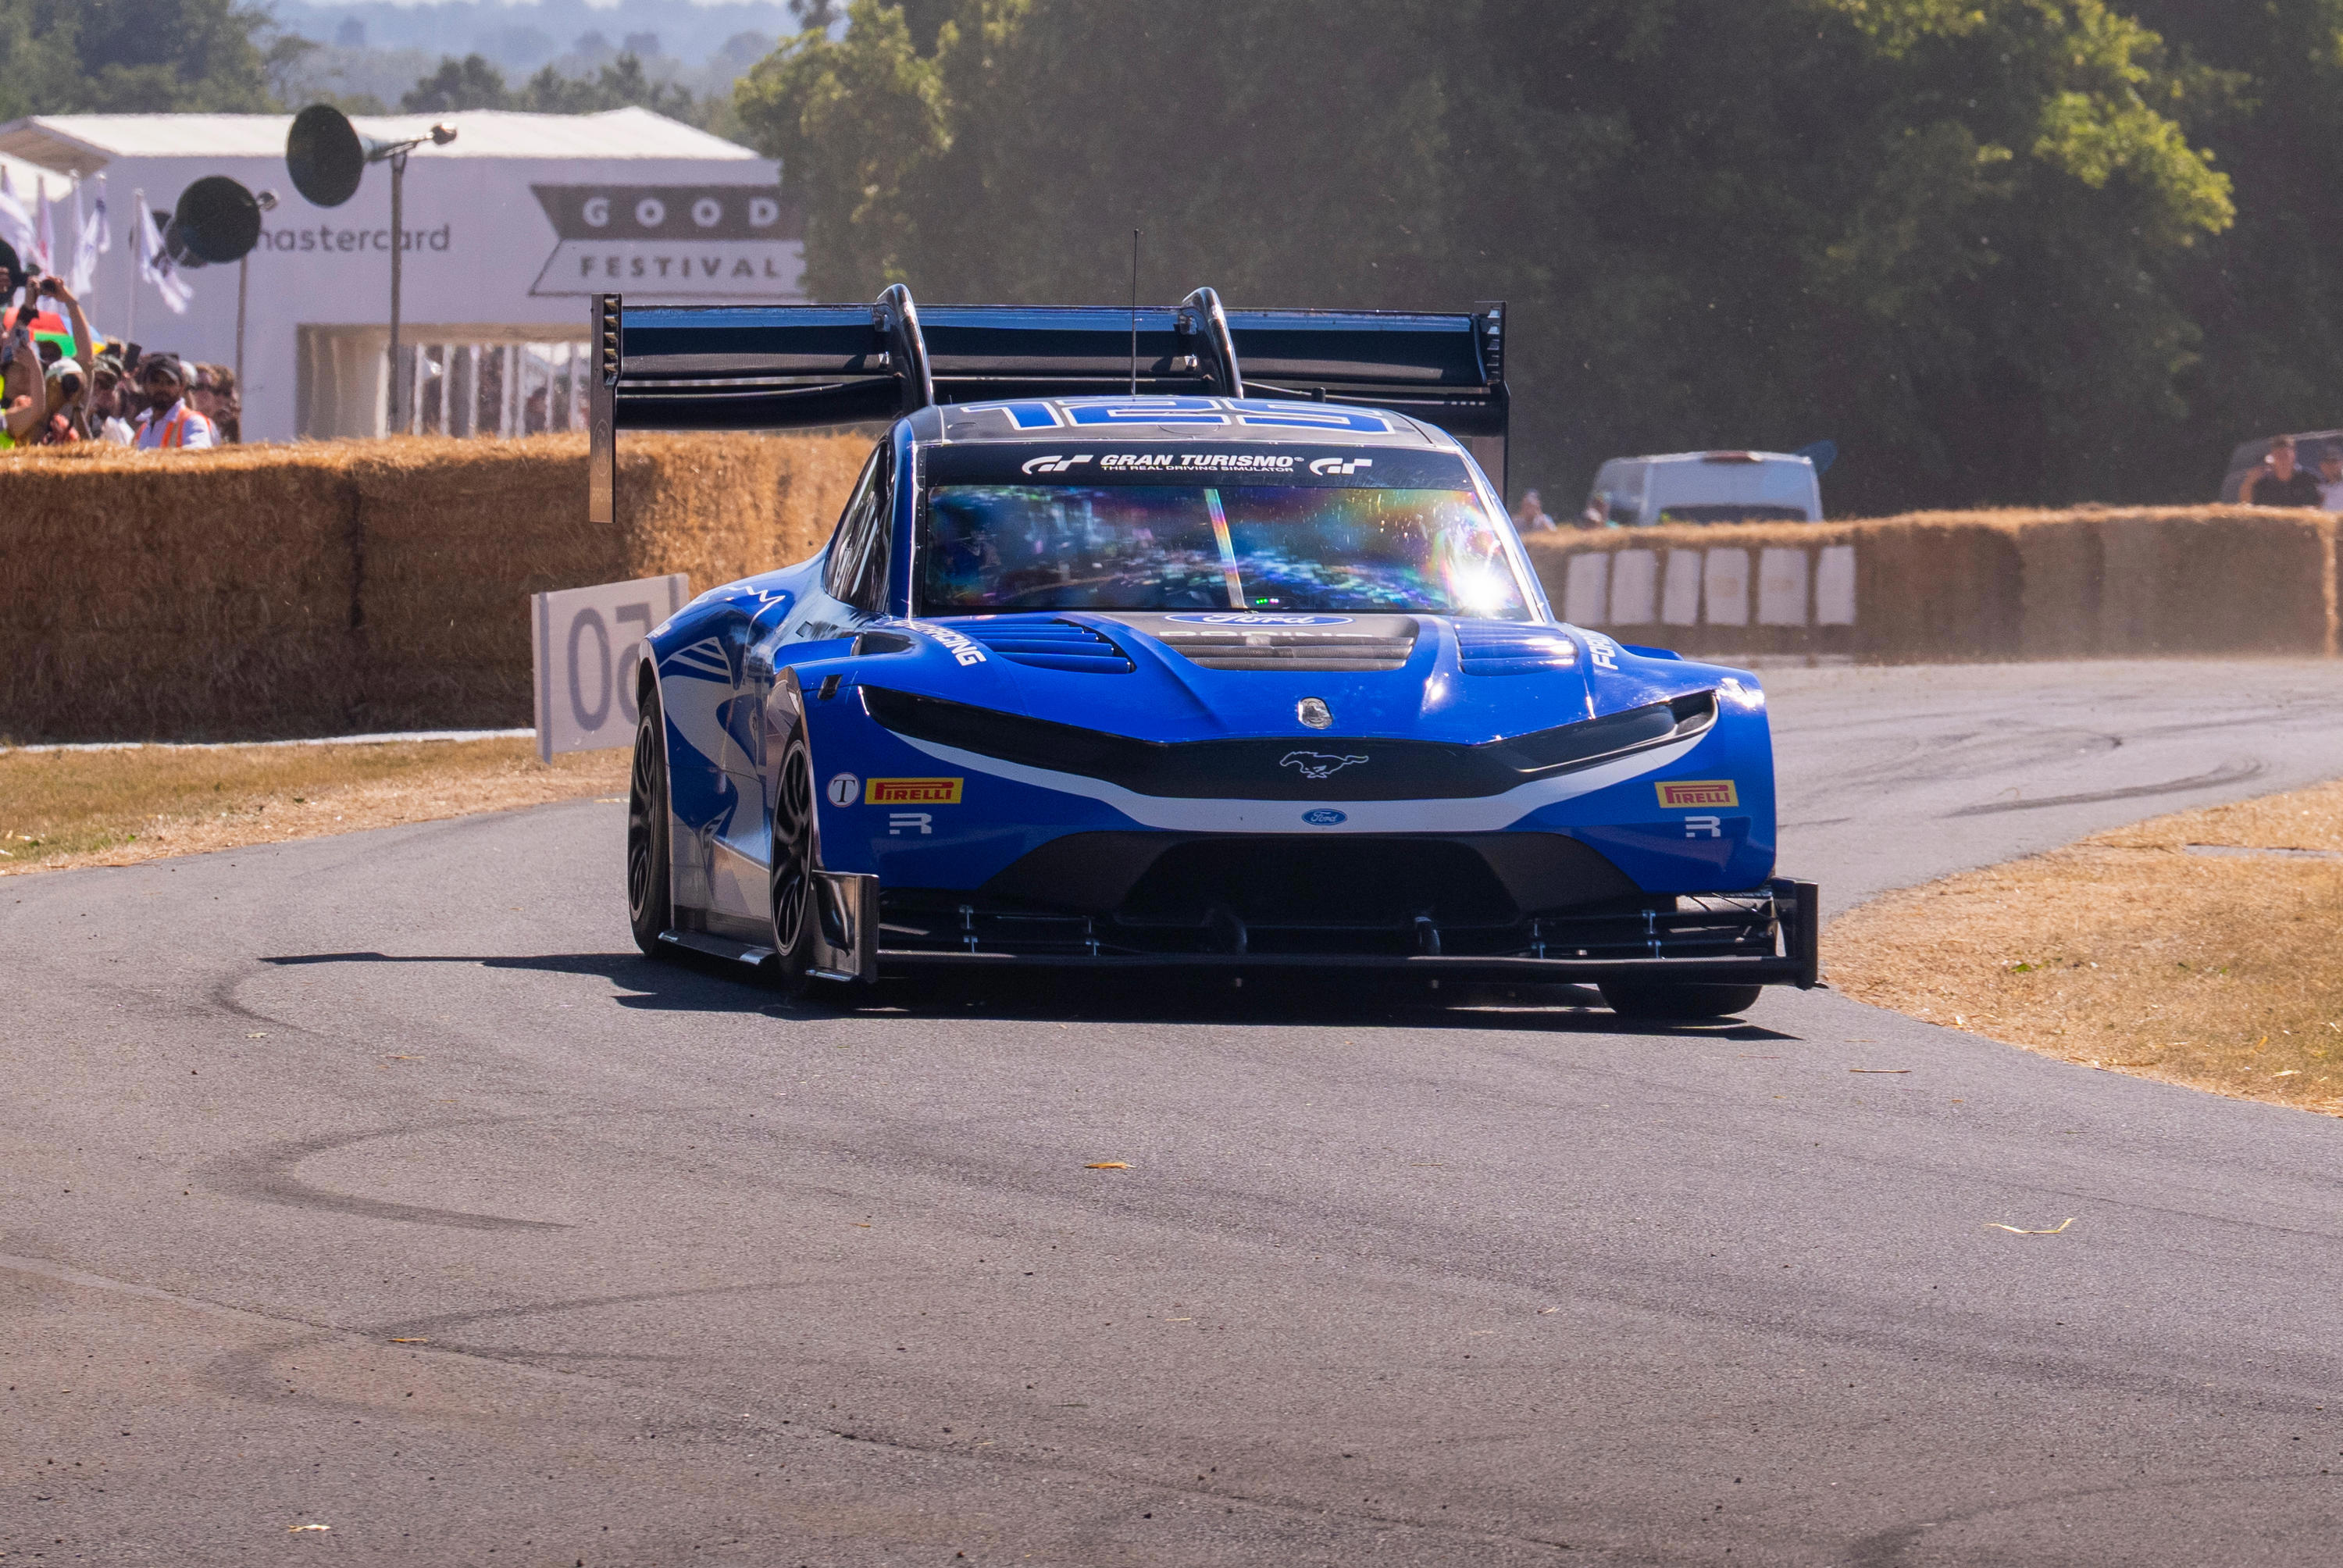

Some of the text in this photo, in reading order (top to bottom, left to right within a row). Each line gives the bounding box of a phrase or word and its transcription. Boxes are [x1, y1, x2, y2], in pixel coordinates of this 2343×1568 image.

[580, 255, 781, 278] FESTIVAL
[961, 395, 1396, 434] 125
[1100, 454, 1174, 466] GRAN
[1203, 614, 1316, 624] Ford
[874, 782, 954, 800] PIRELLI
[1664, 785, 1731, 804] PIRELLI
[1311, 811, 1338, 822] Ford
